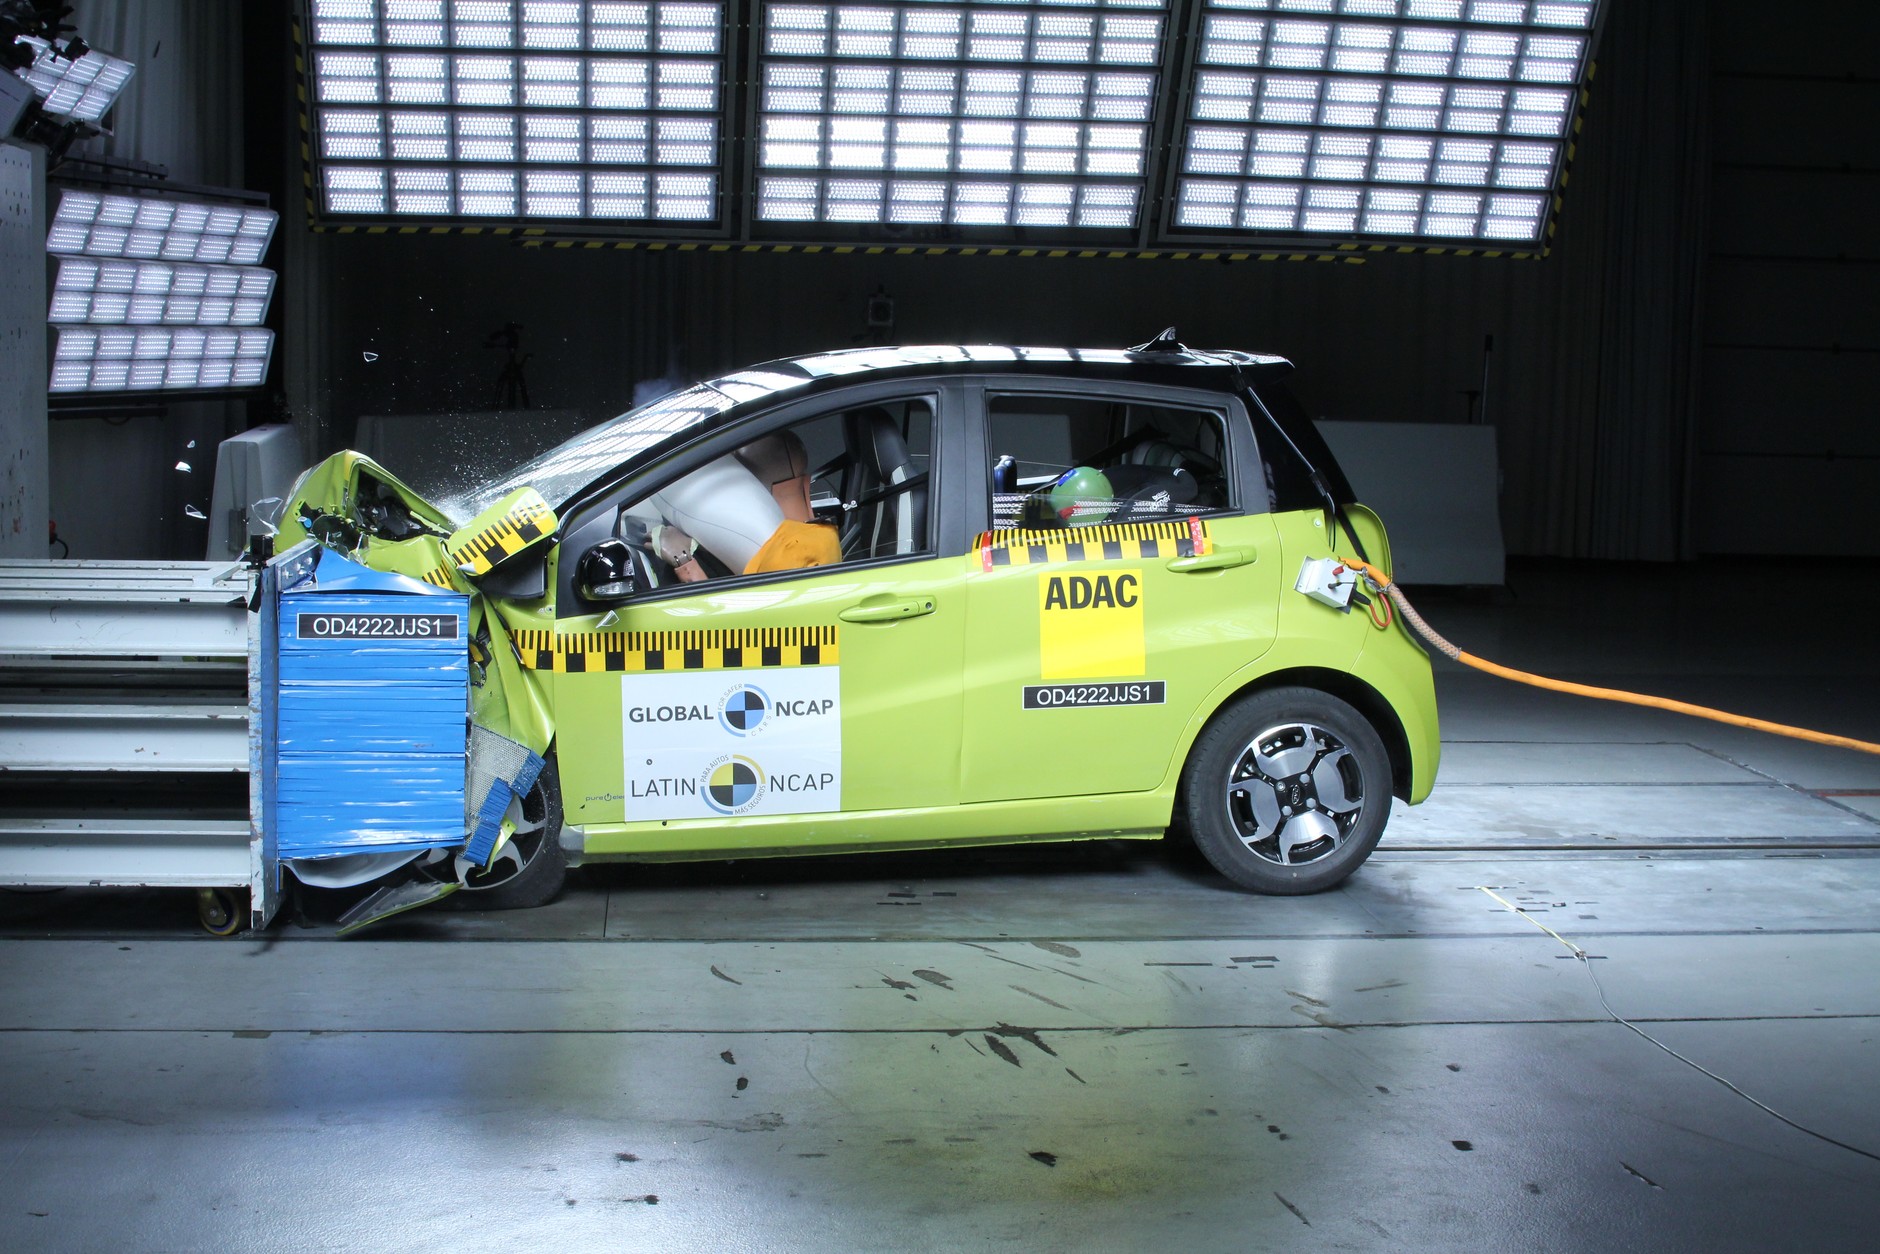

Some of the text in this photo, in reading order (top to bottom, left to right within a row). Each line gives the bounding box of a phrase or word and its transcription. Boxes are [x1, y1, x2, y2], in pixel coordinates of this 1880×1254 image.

[1044, 574, 1138, 610] ADAC
[313, 617, 442, 636] OD4222JJS1
[717, 683, 743, 710] FOR SAFER
[1036, 685, 1151, 706] OD4222JJS1
[628, 699, 834, 723] GLOBAL NCAP
[750, 714, 772, 737] CARS
[700, 754, 729, 783] PARA AUTOS
[631, 773, 834, 798] LATIN NCAP
[747, 784, 766, 810] SEGUROS
